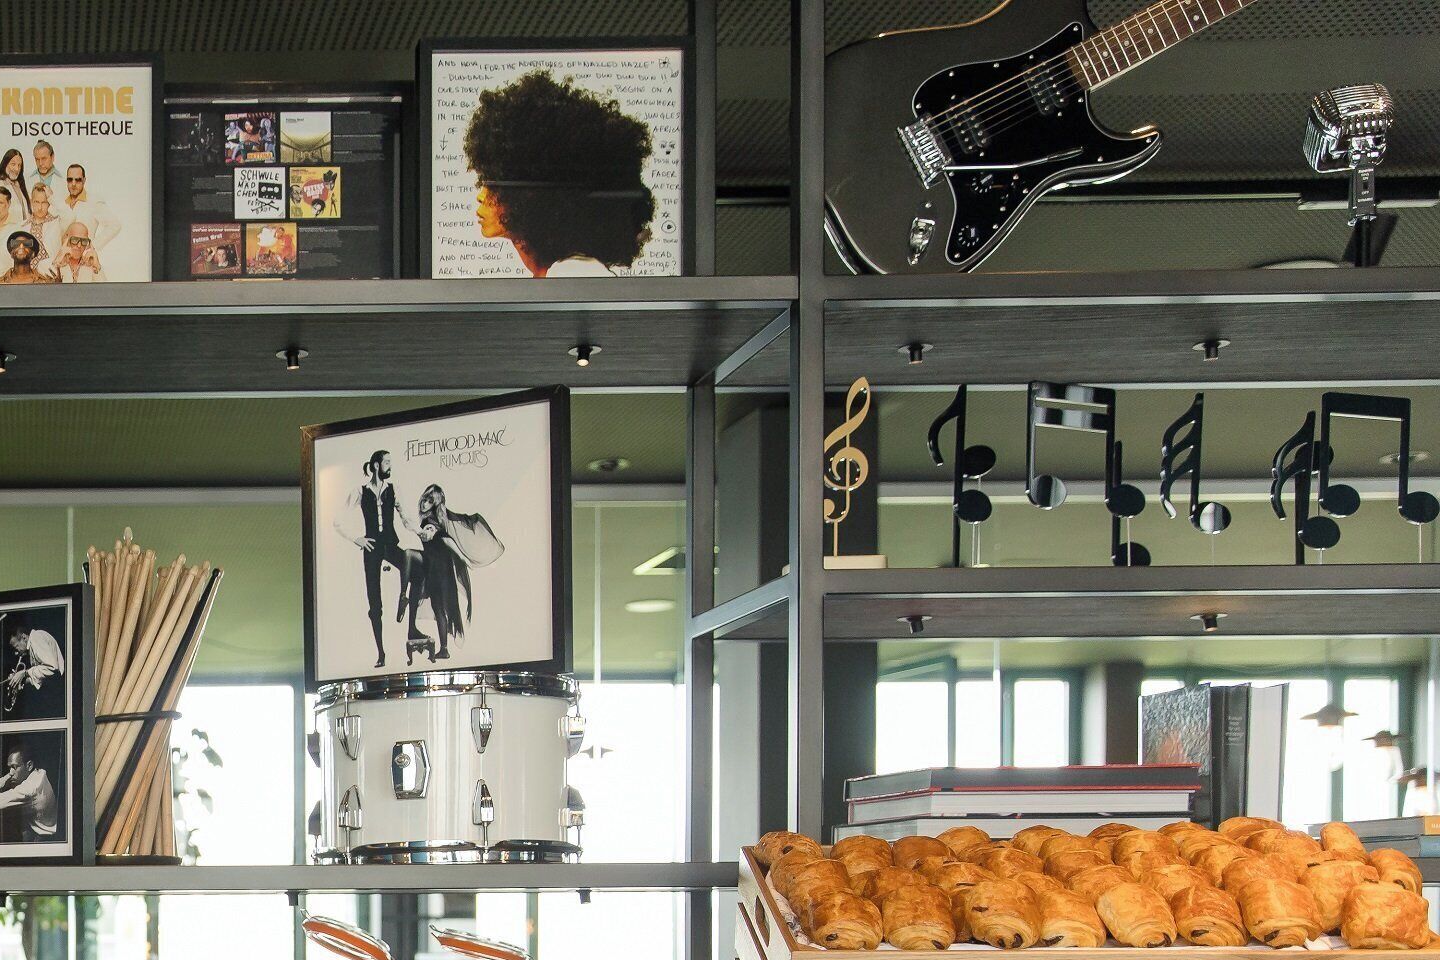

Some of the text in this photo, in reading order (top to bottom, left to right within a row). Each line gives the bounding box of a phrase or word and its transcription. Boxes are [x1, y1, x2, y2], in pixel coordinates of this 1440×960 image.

[437, 99, 457, 107] TOUR
[626, 99, 675, 107] SOMEWHERE
[437, 113, 466, 121] IN THE
[644, 112, 680, 120] JUNGLES
[11, 120, 134, 136] DISCOTHEQUE
[651, 183, 679, 191] METER
[478, 266, 511, 275] AFRAID
[404, 425, 513, 462] FLEETWOOD MAC
[440, 449, 489, 471] RUMOURS
